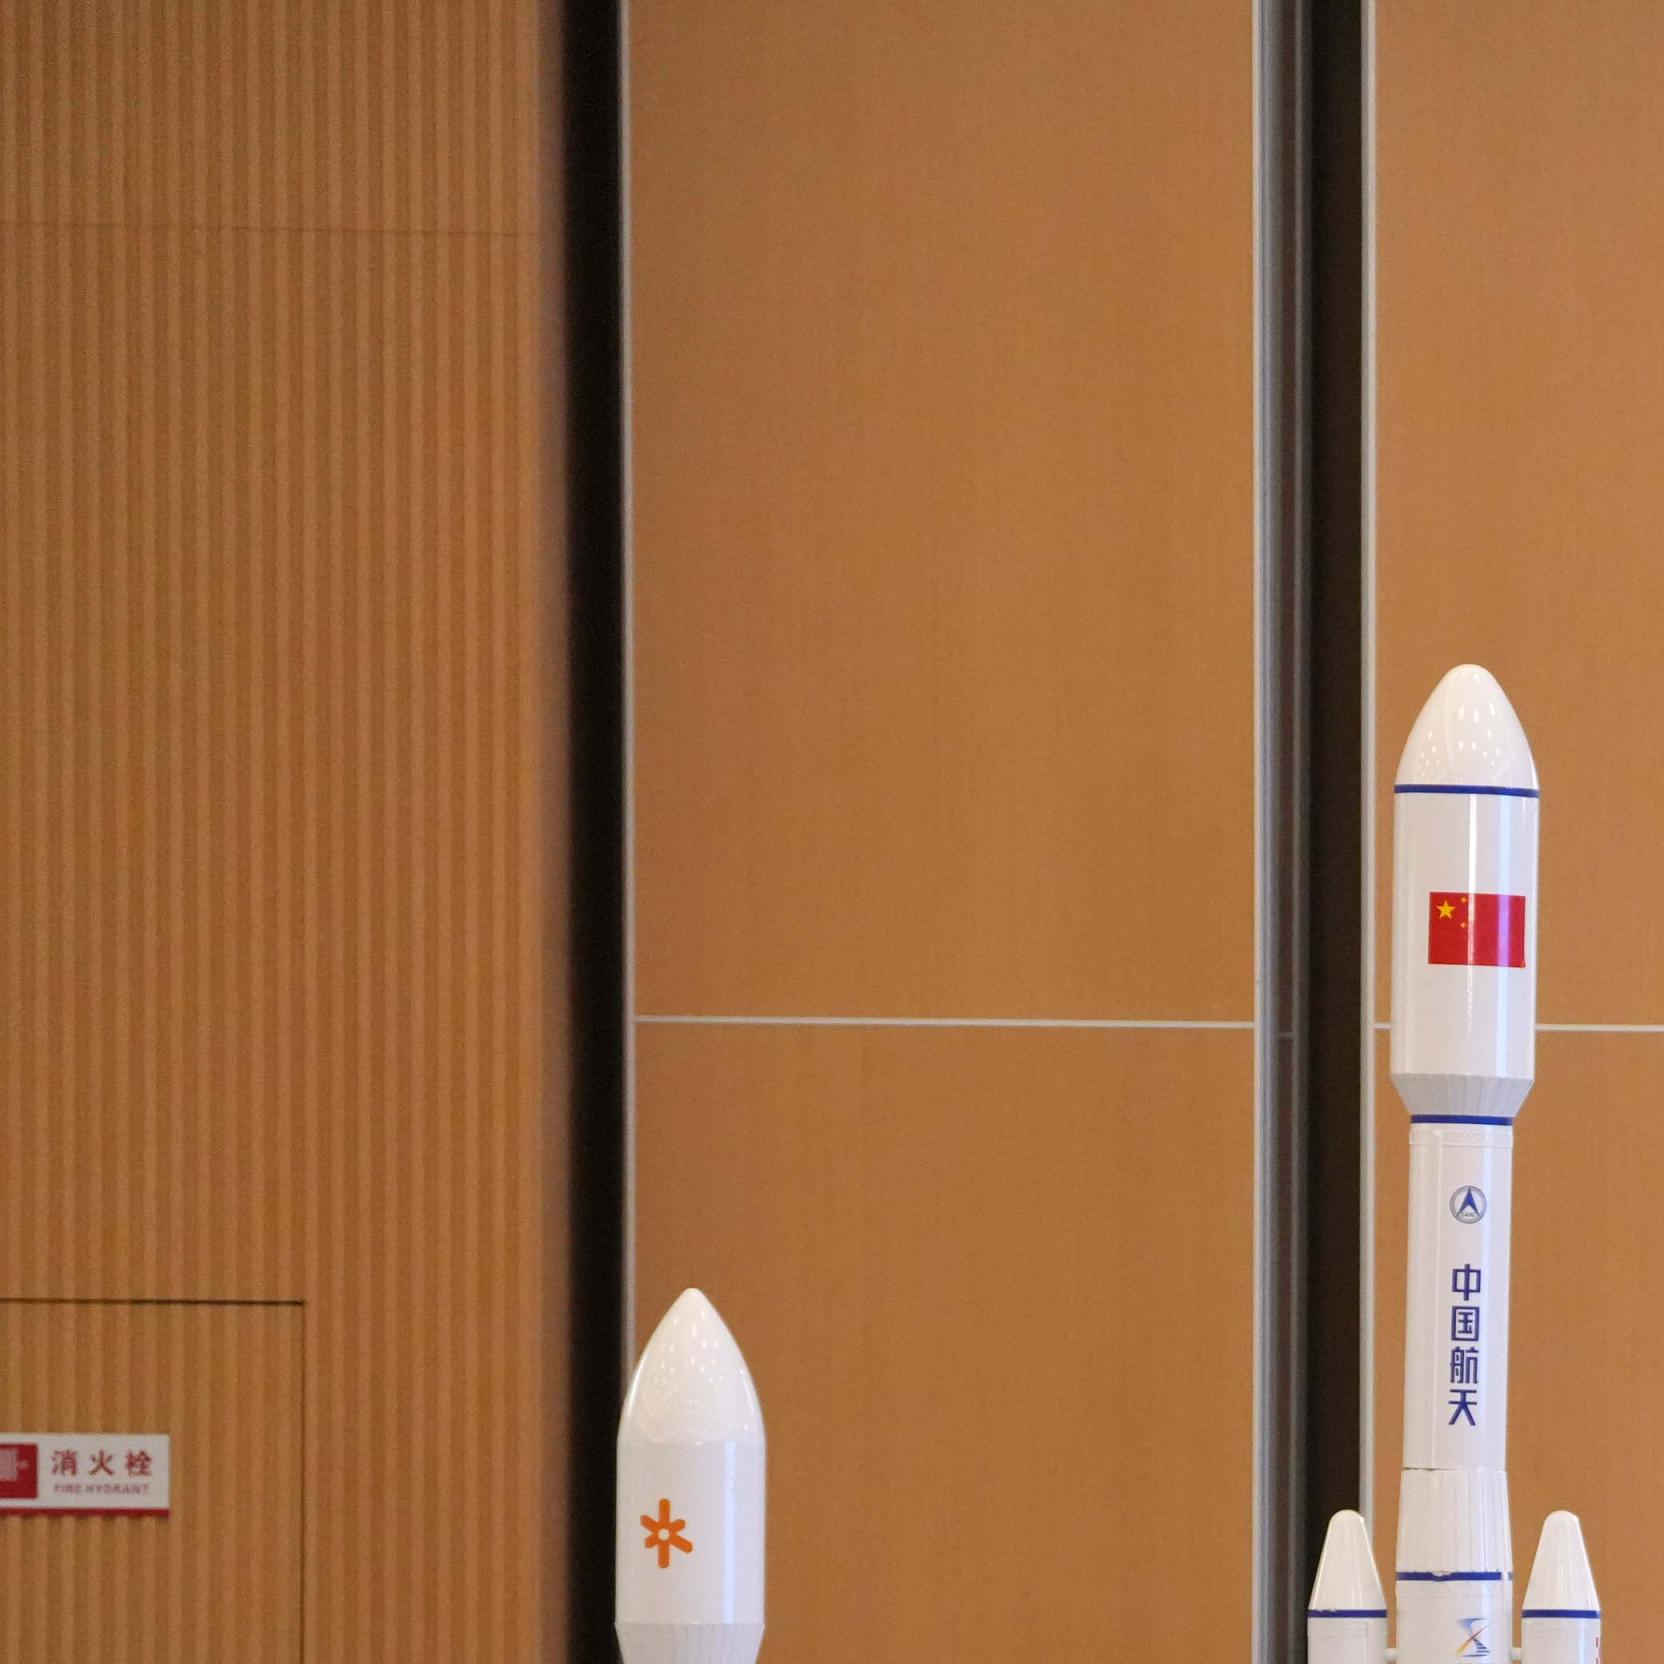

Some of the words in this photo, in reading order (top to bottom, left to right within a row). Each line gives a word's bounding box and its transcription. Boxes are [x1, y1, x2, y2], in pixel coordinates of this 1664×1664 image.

[1448, 1263, 1482, 1427] 中国航天
[51, 1449, 152, 1477] 消火栓
